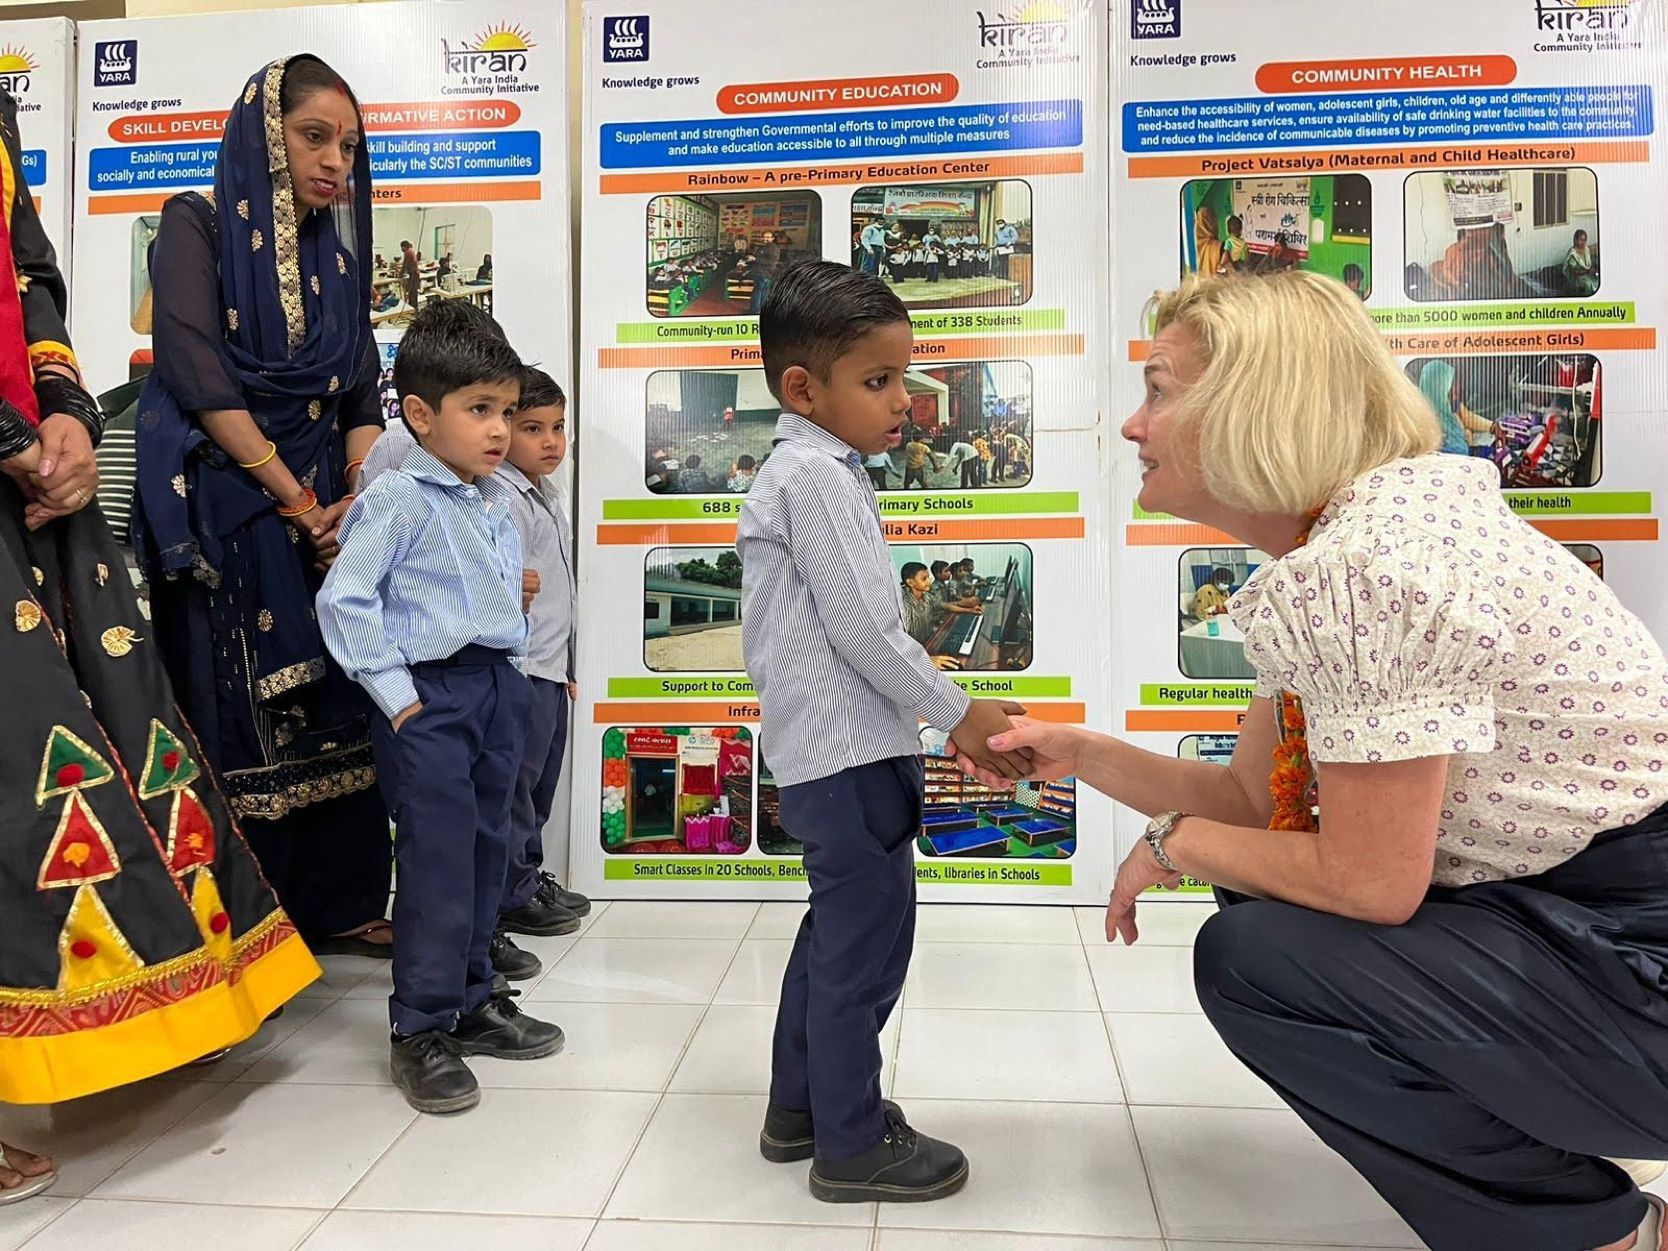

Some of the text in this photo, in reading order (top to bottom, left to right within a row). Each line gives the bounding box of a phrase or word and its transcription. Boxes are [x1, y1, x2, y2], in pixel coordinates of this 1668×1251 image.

[1137, 24, 1174, 34] YARA
[1556, 32, 1564, 42] A
[1567, 32, 1590, 42] Yara
[608, 48, 643, 58] YARA
[1533, 42, 1592, 52] Community
[440, 38, 527, 74] kiran
[1130, 53, 1236, 66] Knowledge grows
[976, 57, 1031, 69] Community
[99, 72, 131, 82] YARA
[462, 74, 518, 85] A Yara India
[1291, 65, 1481, 83] COMMUNITY HEALTH
[602, 76, 699, 88] Knowledge grows
[441, 83, 539, 95] Community Initiative
[734, 82, 941, 105] COMMUNITY EDUCATION
[92, 98, 182, 111] Knowledge grows
[1136, 106, 1179, 117] Enhance
[1181, 105, 1197, 116] the
[1199, 103, 1261, 115] accessibility
[1263, 102, 1274, 113] of
[1276, 102, 1315, 112] women,
[1318, 99, 1373, 110] adolescent
[1376, 98, 1402, 111] girls,
[1404, 98, 1447, 109] children,
[1450, 96, 1466, 106] old
[1468, 96, 1487, 107] age
[1490, 94, 1508, 104] and
[1511, 93, 1561, 107] differently
[443, 108, 505, 120] ACTION
[1137, 120, 1195, 131] need-based
[1197, 119, 1249, 129] healthcare
[1252, 117, 1296, 128] services,
[1298, 116, 1333, 125] ensure
[1336, 113, 1390, 126] availability
[1392, 112, 1402, 122] of
[1404, 112, 1426, 122] safe
[1429, 110, 1470, 123] drinking
[1473, 109, 1501, 118] water
[1503, 108, 1545, 118] facilities
[1548, 108, 1558, 117] to
[1561, 106, 1576, 116] the
[123, 122, 166, 135] SKILL
[615, 110, 1065, 144] Supplement and strengthen Governmental efforts to improve the quality of education
[1140, 134, 1159, 145] and
[1161, 134, 1195, 144] reduce
[1198, 133, 1214, 143] the
[1216, 132, 1264, 142] incidence
[1266, 131, 1277, 140] of
[1279, 129, 1352, 140] communicable
[1355, 127, 1400, 137] diseases
[1402, 127, 1415, 138] by
[1418, 125, 1470, 136] promoting
[1472, 124, 1525, 134] preventive
[1527, 123, 1559, 131] health
[1561, 122, 1583, 131] care
[387, 139, 496, 154] building and support
[668, 130, 1009, 155] and make education accessible to all through multiple measures
[130, 148, 199, 164] Enabling rural
[1202, 147, 1575, 172] Project Vatsalya (Maternal and Child Healthcare)
[370, 154, 532, 173] icularly the SC/ST communities
[97, 165, 214, 183] socially and economical
[688, 162, 989, 185] Rainbow A pre-Primary Education Center
[372, 189, 402, 198] nters
[936, 315, 1021, 328] of 338 Students
[1395, 307, 1626, 323] than 5000 women and children Annually
[657, 325, 732, 337] Community-run
[735, 323, 748, 334] 10
[1407, 338, 1439, 349] Care
[1444, 336, 1458, 348] of
[1463, 335, 1542, 348] Adolescent
[1546, 332, 1584, 346] Girls)
[731, 348, 763, 360] Prim
[912, 343, 945, 354] ation
[702, 501, 730, 513] 688
[879, 497, 973, 512] rimary Schools
[1508, 496, 1571, 508] their health
[908, 523, 937, 535] Kazi
[662, 680, 723, 693] Support to
[971, 680, 1012, 691] School
[1159, 687, 1253, 701] Regular health
[728, 705, 760, 716] Infra
[634, 863, 775, 876] Smart Classes in 20 Schools,
[944, 868, 1040, 880] libraries in Schools
